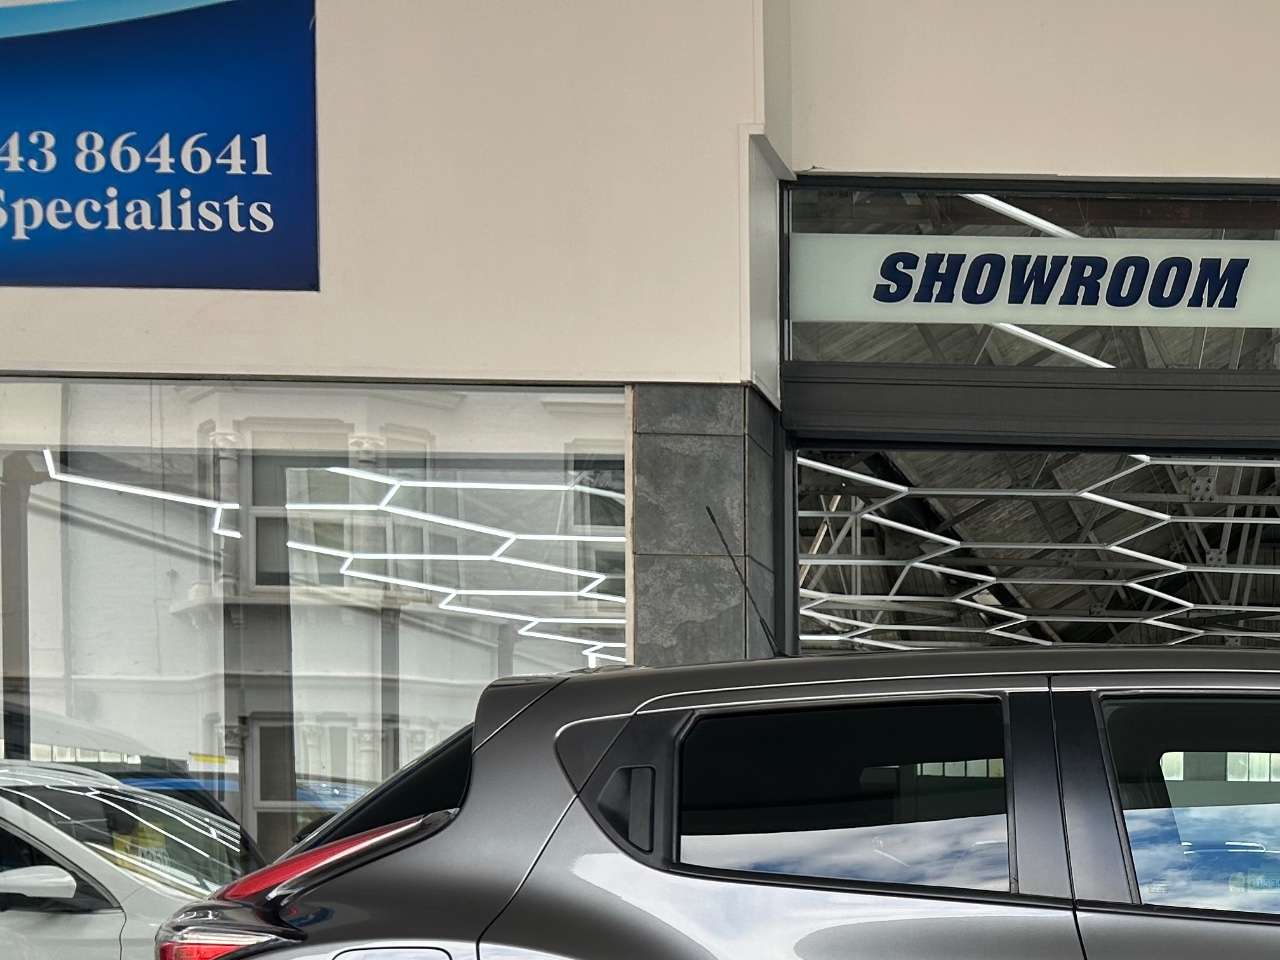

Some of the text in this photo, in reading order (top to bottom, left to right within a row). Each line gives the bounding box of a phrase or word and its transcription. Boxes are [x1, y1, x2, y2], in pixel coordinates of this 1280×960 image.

[0, 131, 272, 175] 43 864641
[873, 252, 1249, 308] SHOWROOM
